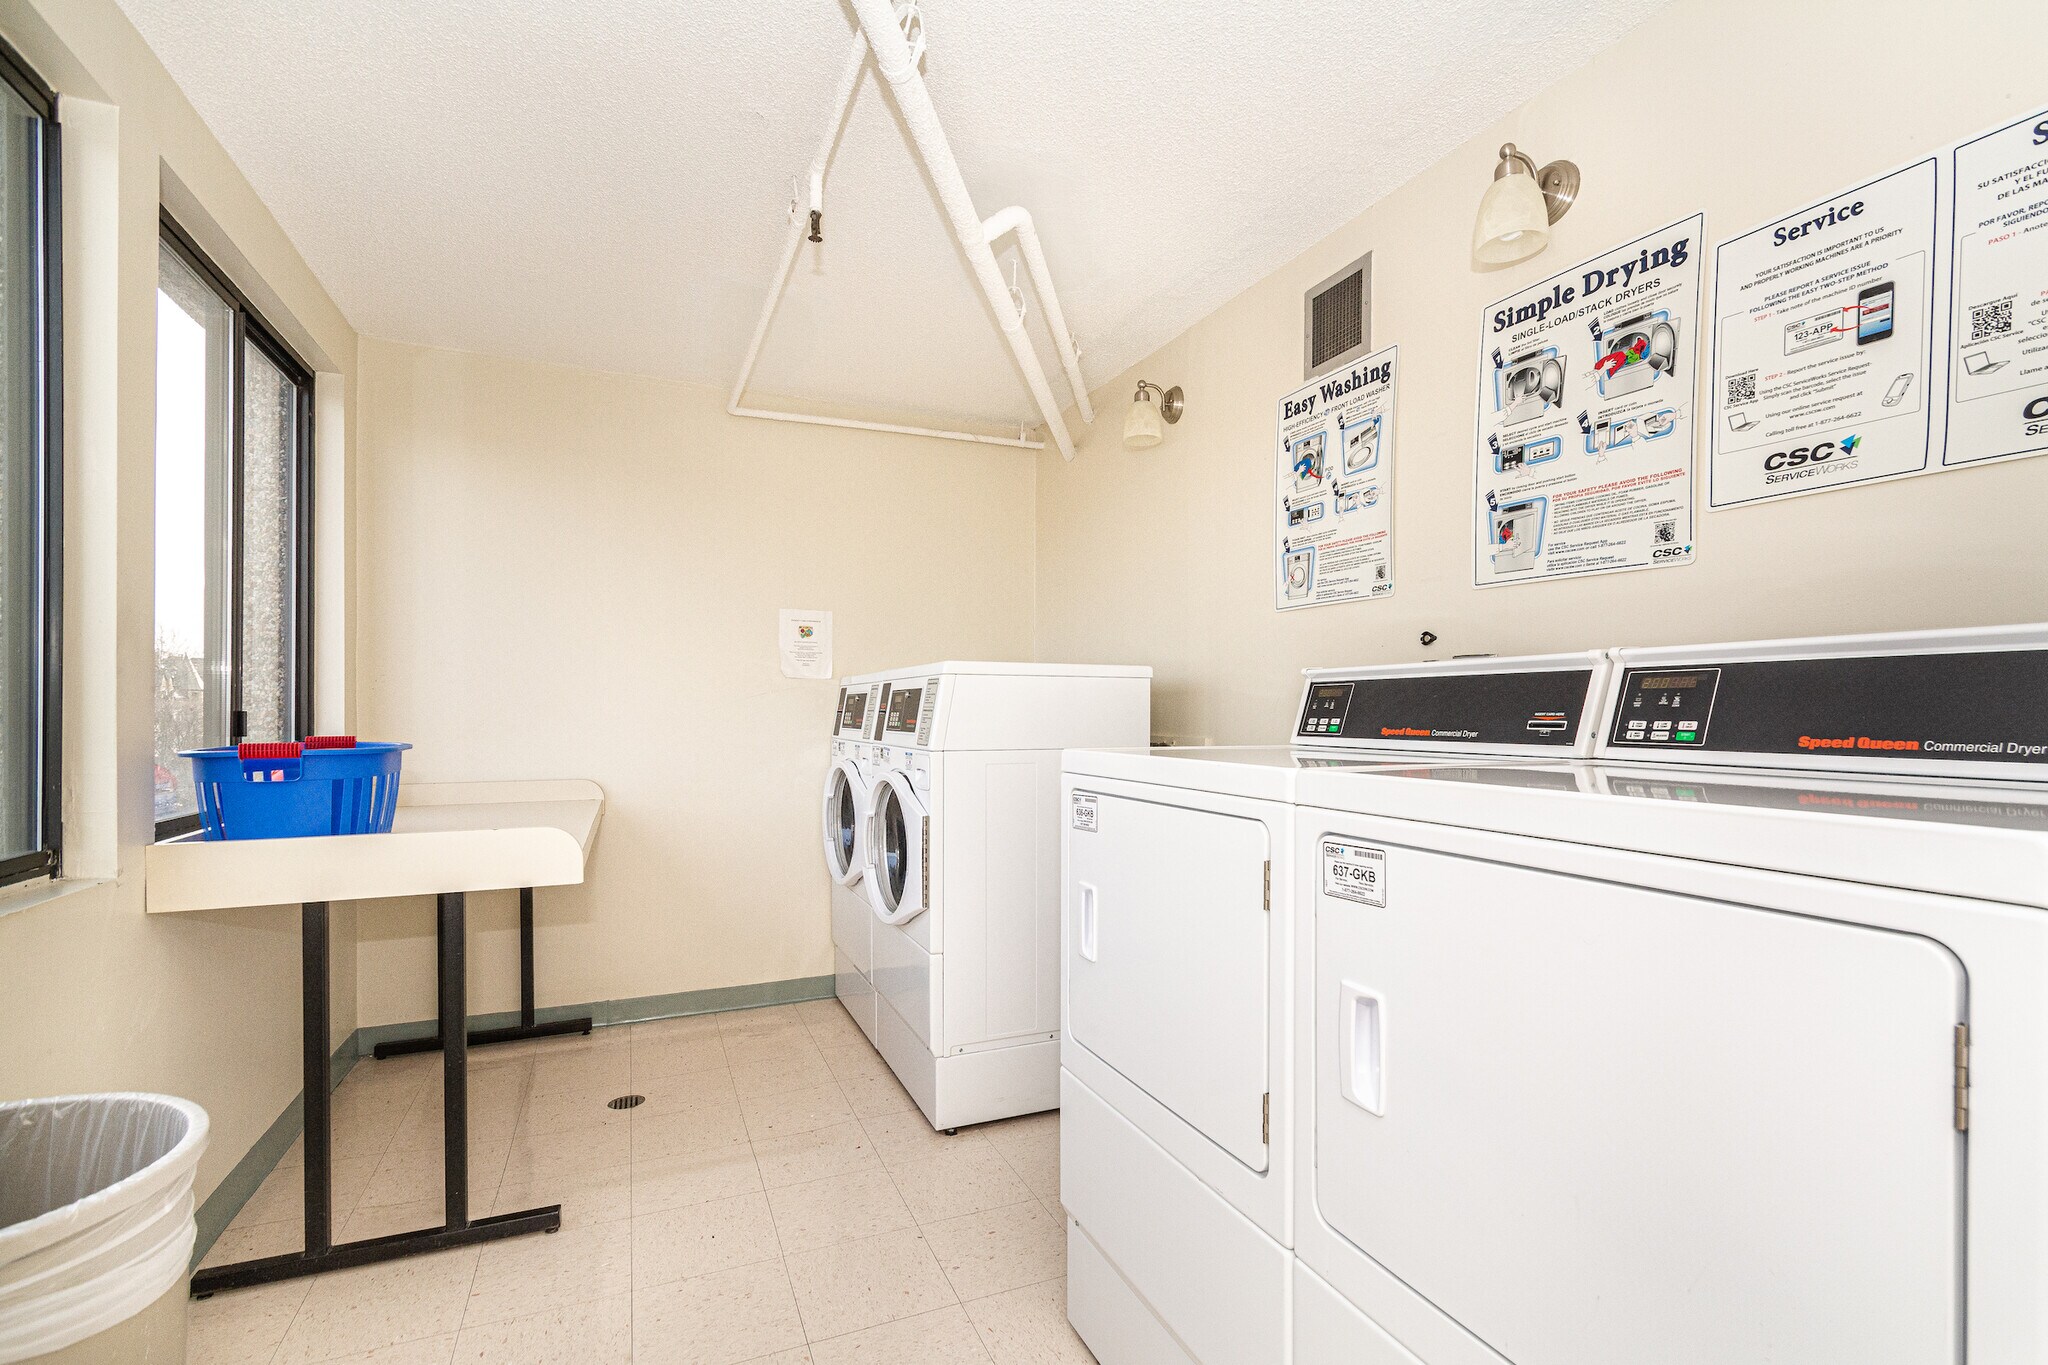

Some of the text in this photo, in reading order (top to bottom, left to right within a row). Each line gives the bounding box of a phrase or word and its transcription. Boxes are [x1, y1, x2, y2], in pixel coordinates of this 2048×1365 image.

[1978, 181, 1989, 190] SU
[2024, 174, 2033, 182] EL
[1998, 184, 2030, 200] DE LAS
[1773, 201, 1864, 247] Service
[1979, 219, 1995, 228] POR
[1997, 208, 2026, 222] FAVOR,
[1988, 234, 2010, 244] PASO
[1740, 283, 1753, 291] AND
[1754, 273, 1783, 286] PROPERLY
[1785, 261, 1814, 275] WORKING
[1816, 248, 1848, 264] MACHINES
[1850, 243, 1863, 251] ARE
[1871, 228, 1903, 244] PRIORITY
[1756, 269, 1772, 278] YOUR
[1773, 253, 1815, 272] SATISFACTION
[1824, 235, 1862, 253] IMPORTANT
[1494, 238, 1689, 333] Simple Drying
[1749, 263, 1888, 314] FOLLOWING THE EASY TWO-STEP METHOD
[1765, 292, 1787, 301] PLEASE
[1789, 282, 1813, 293] REPORT
[1822, 268, 1849, 282] SERVICE
[1851, 261, 1870, 272] ISSUE
[1754, 314, 1767, 322] STEP
[1823, 288, 1847, 299] machine
[1858, 277, 1882, 288] number
[1968, 299, 2001, 310] Descargue
[1512, 279, 1661, 342] SINGLE-LOAD/STACK DRYERS
[1594, 327, 1600, 335] 2
[1794, 323, 1833, 340] 123-APP
[2003, 330, 2023, 338] Service
[1787, 367, 1806, 376] Report
[1818, 358, 1838, 366] service
[2020, 367, 2042, 376] Llame
[1794, 375, 1827, 386] ServiceWorks
[1828, 369, 1846, 377] Service
[1284, 395, 1316, 420] Easy
[1320, 362, 1391, 403] Washing
[1833, 393, 1855, 402] request
[1283, 412, 1323, 432] HIGH-EFFICIENCY
[1331, 401, 1349, 413] FRONT
[1350, 395, 1364, 405] LOAD
[1366, 384, 1390, 398] WASHER
[1790, 405, 1835, 419] www.cscsw.com
[1764, 443, 1835, 470] CSC
[1650, 468, 1682, 478] FOLLOWING
[1653, 547, 1682, 557] CSC
[1381, 727, 1478, 739] Speed Queen Commercial Dryer
[1798, 736, 2046, 756] Speed Queen Commercial Dryer
[1333, 865, 1375, 882] 637-GKB
